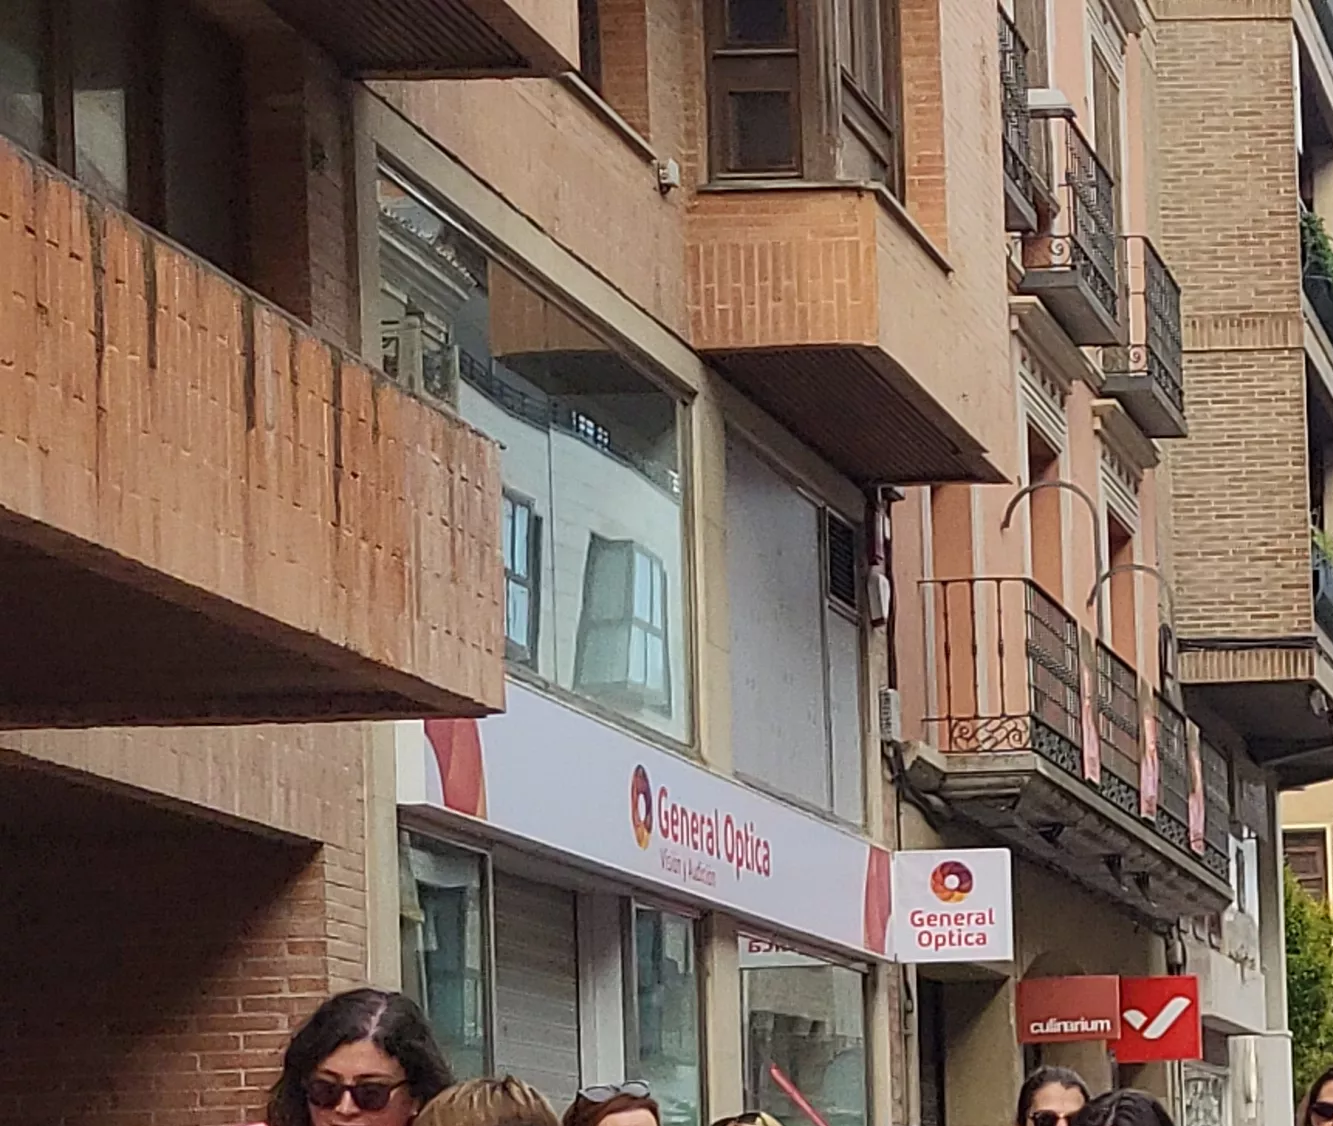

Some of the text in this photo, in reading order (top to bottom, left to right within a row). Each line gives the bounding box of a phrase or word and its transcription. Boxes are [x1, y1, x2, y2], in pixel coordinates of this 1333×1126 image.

[658, 786, 771, 881] General Optica
[910, 908, 996, 928] General
[917, 929, 988, 951] Optica
[1030, 1017, 1111, 1035] culinarium
